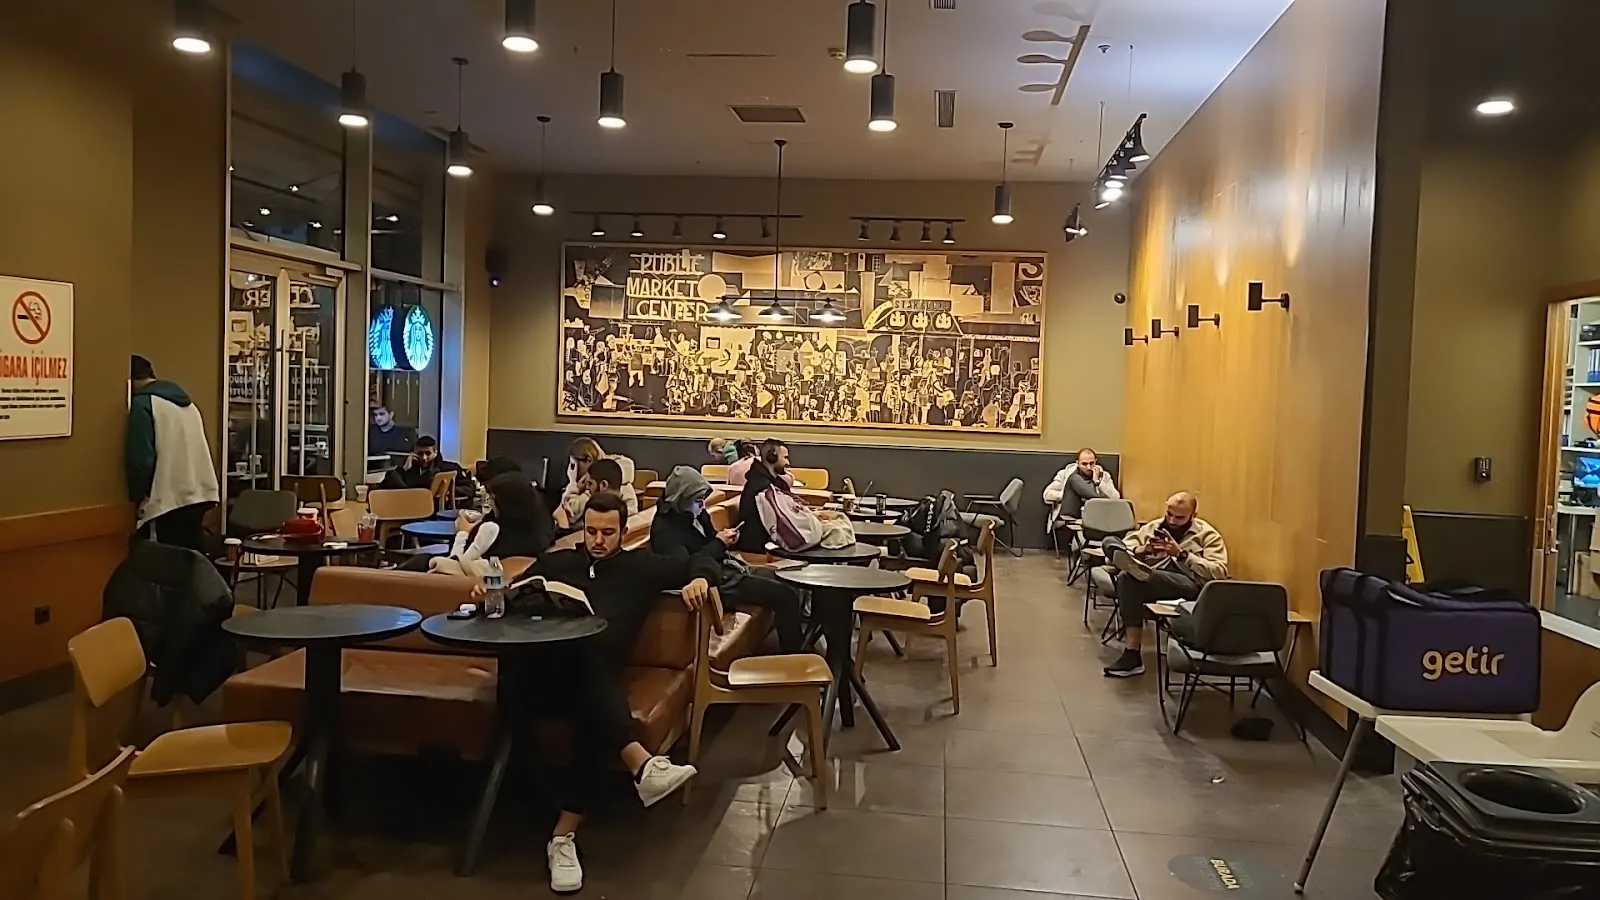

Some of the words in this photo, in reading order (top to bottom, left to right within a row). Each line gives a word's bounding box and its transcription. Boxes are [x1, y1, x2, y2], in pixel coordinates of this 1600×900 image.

[627, 277, 699, 298] MARKET
[636, 300, 709, 321] CENTER
[0, 349, 28, 378] İGARA
[1422, 645, 1505, 680] getir
